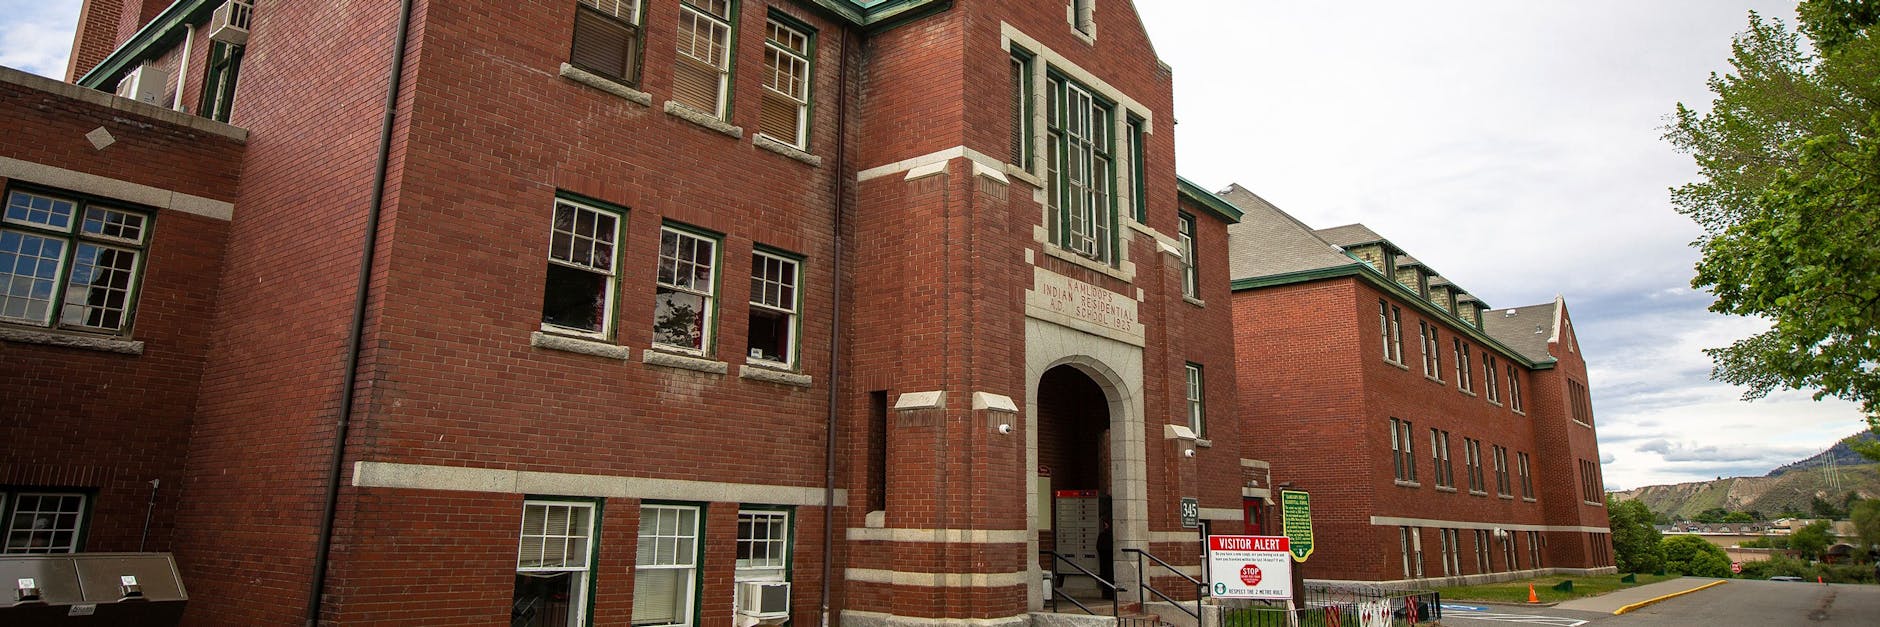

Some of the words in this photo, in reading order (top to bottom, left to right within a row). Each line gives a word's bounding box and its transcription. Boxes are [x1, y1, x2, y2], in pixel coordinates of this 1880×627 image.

[1043, 283, 1073, 302] INDIAN
[1081, 295, 1133, 321] RESIDENTIAL
[1076, 306, 1108, 325] SCHOOL
[1183, 503, 1197, 517] 345
[1219, 538, 1252, 550] VISITOR
[1254, 539, 1280, 550] ALERT
